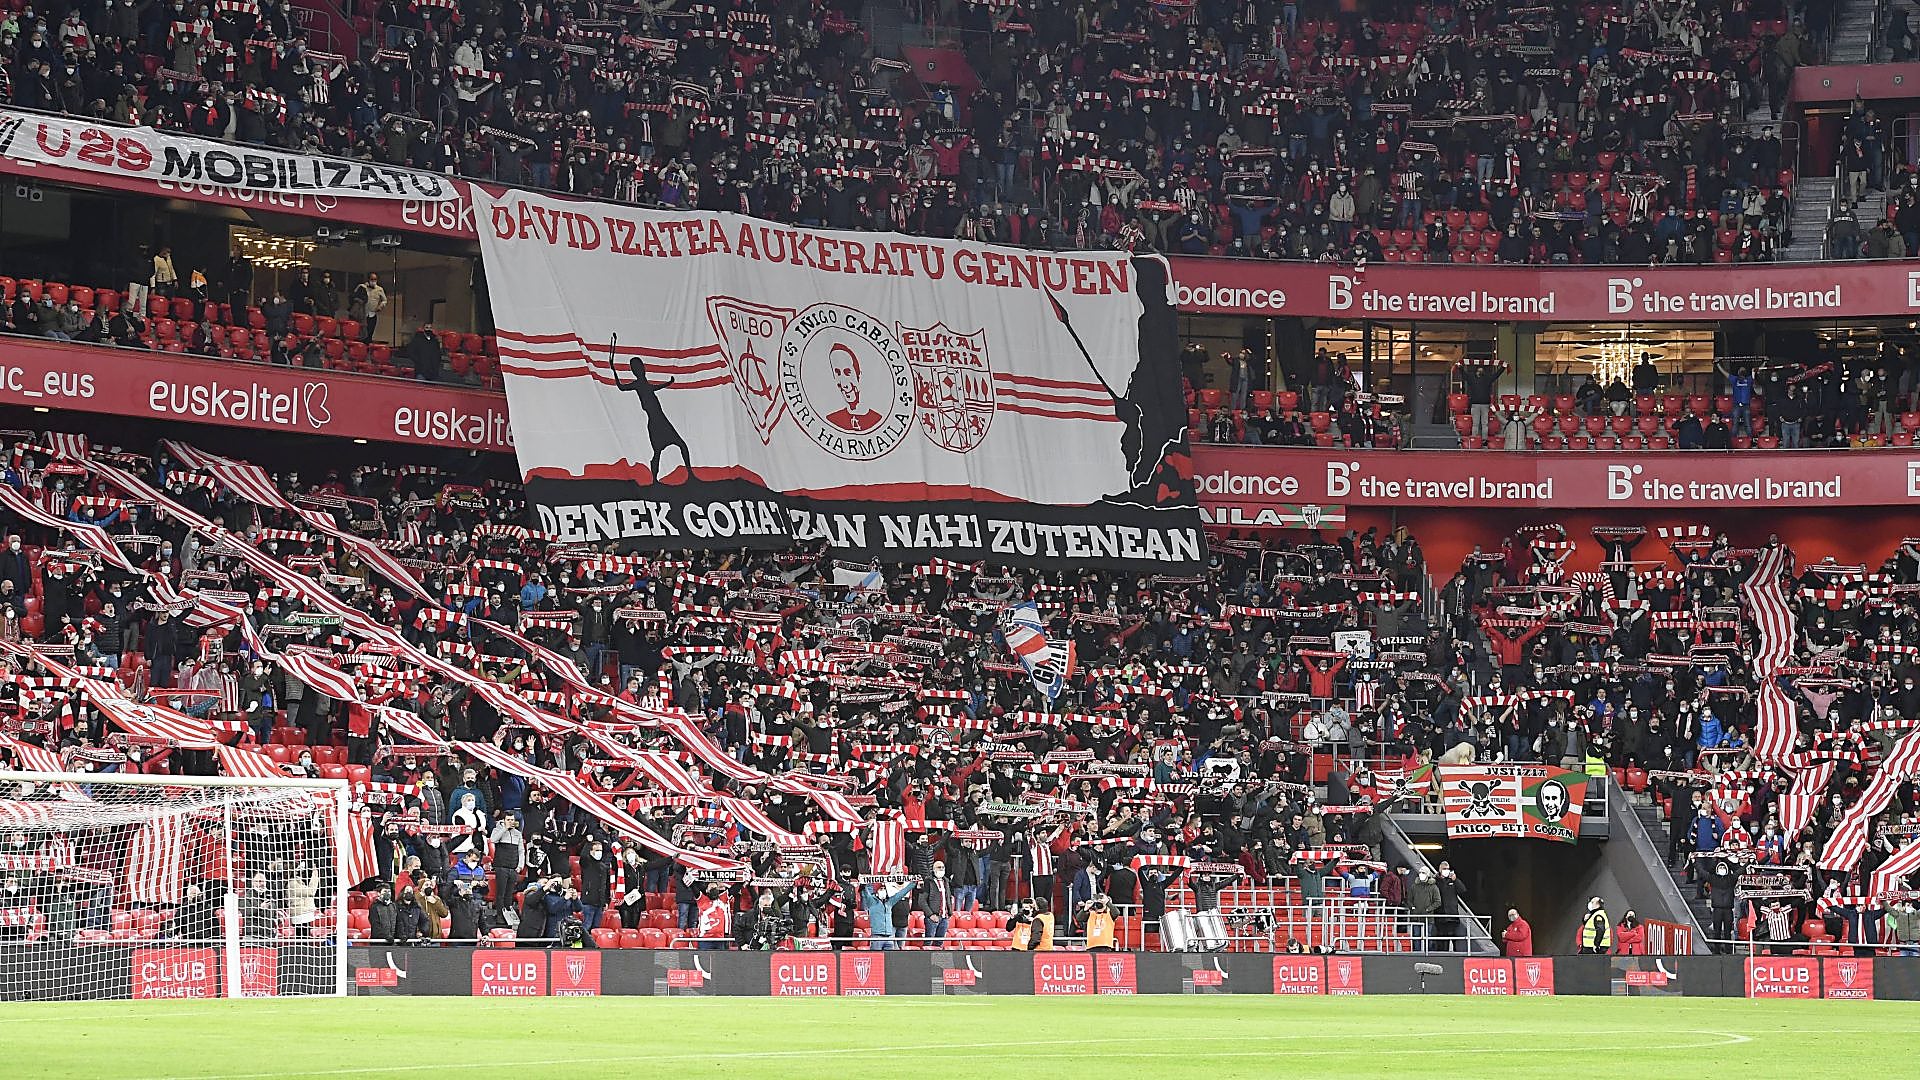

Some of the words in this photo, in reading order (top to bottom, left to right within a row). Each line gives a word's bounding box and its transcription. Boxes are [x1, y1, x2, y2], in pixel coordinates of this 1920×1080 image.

[162, 146, 443, 197] MOBILIZATU
[491, 200, 600, 250] DAVID
[603, 217, 731, 258] IZATEA
[735, 222, 945, 280] AUKERATU
[952, 249, 1129, 295] GENUEN
[1362, 290, 1403, 312] the
[1408, 291, 1476, 313] travel
[1482, 291, 1555, 314] brand
[1643, 291, 1684, 313] the
[1690, 287, 1760, 312] travel
[1766, 284, 1841, 310] brand
[730, 310, 773, 338] BILBO
[845, 314, 908, 387] CABACAS
[902, 331, 981, 352] EUSKAL
[149, 380, 299, 425] euskaltel
[782, 360, 816, 428] HERRI
[817, 411, 910, 457] HARMAILA
[1359, 476, 1401, 498] the
[1405, 478, 1474, 499] travel
[1480, 477, 1553, 499] brand
[1643, 478, 1684, 500] the
[1689, 476, 1760, 501] travel
[1766, 475, 1841, 499] brand
[536, 500, 680, 543] DENEK
[879, 513, 982, 548] NAHI
[988, 519, 1200, 562] ZUTENEAN
[323, 617, 340, 626] CLUB
[1351, 661, 1395, 669] JUSTIZIA
[1502, 824, 1529, 832] BETI
[700, 870, 714, 878] ALL
[716, 870, 736, 878] IRON
[142, 962, 206, 982] CLUB
[480, 963, 537, 981] CLUB
[778, 965, 828, 982] CLUB
[1040, 964, 1086, 981] CLUB
[1279, 966, 1319, 982] CLUB
[1469, 968, 1507, 983] CLUB
[1753, 966, 1810, 982] CLUB
